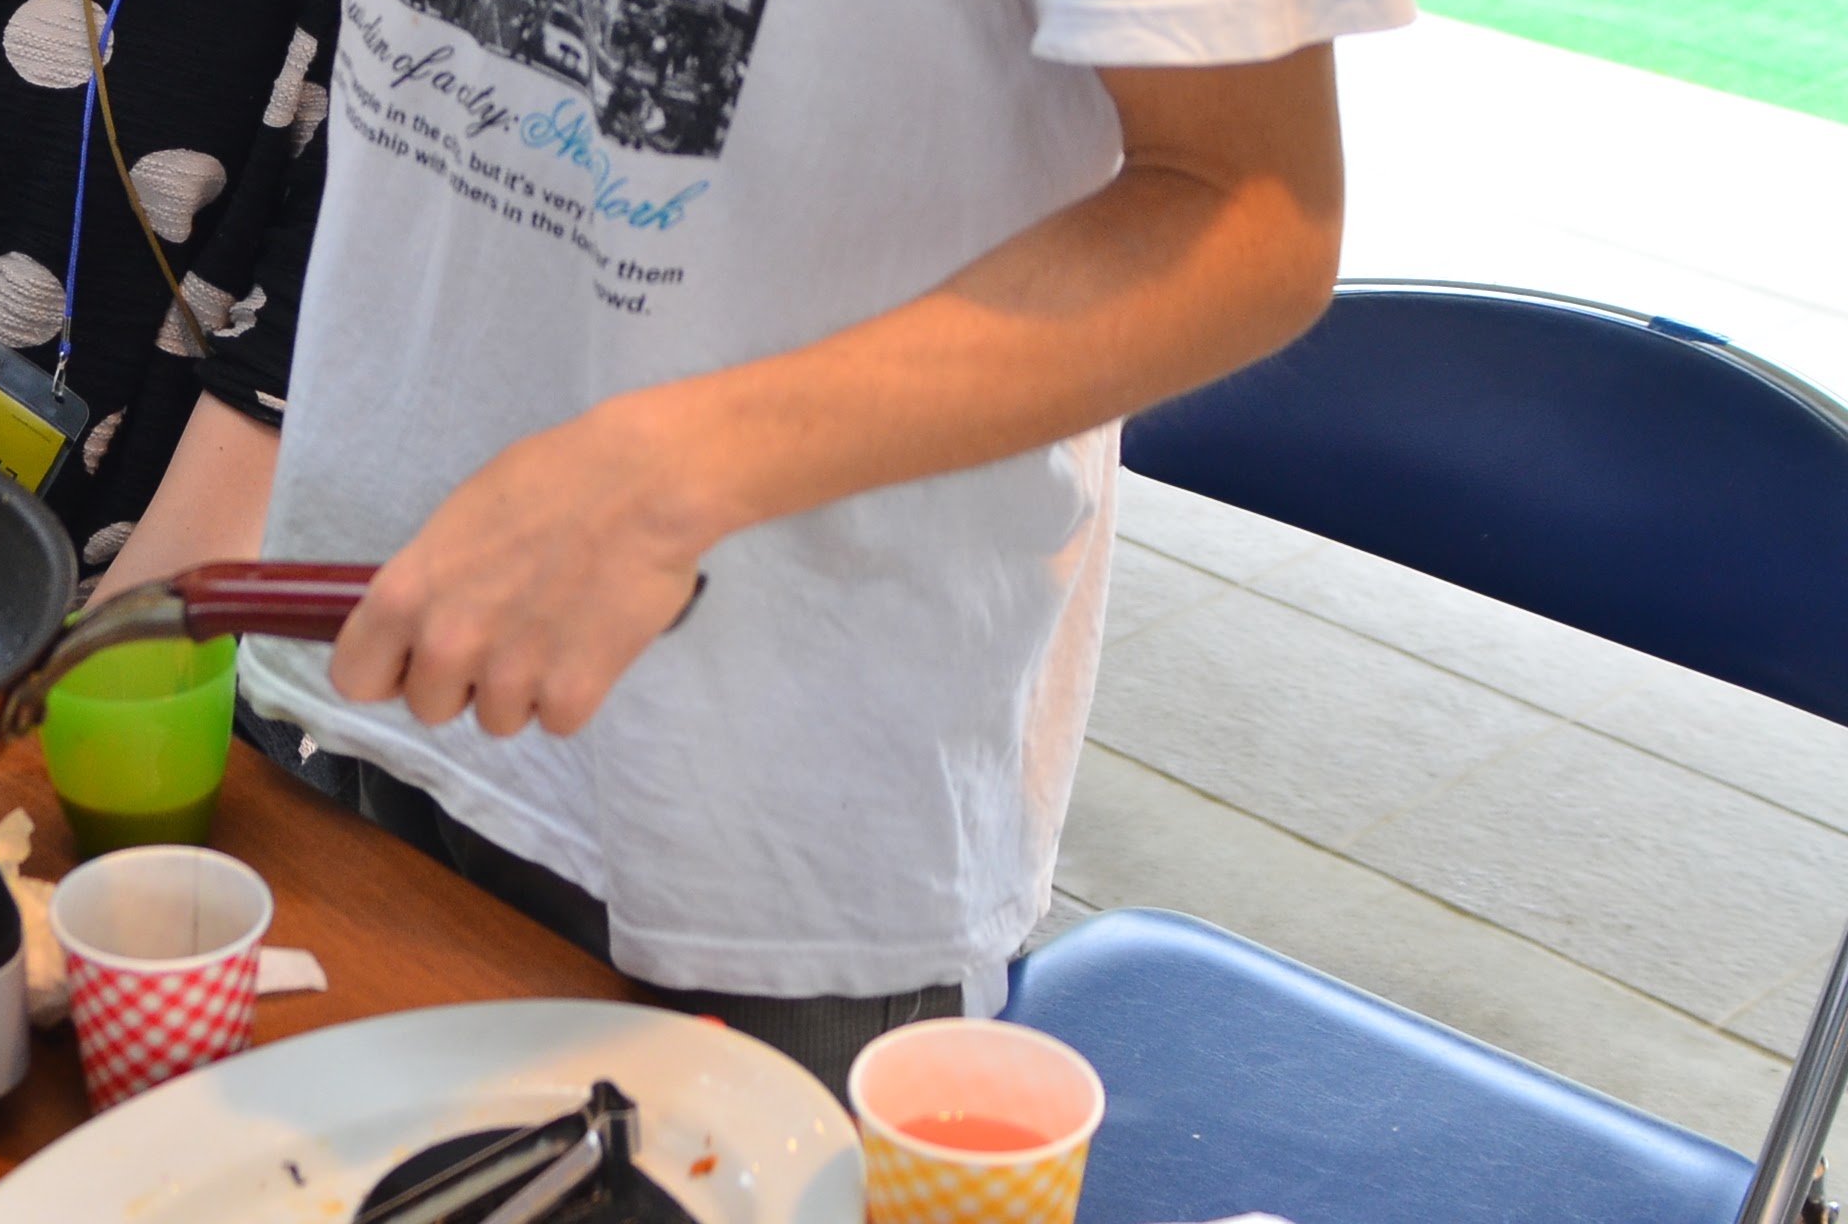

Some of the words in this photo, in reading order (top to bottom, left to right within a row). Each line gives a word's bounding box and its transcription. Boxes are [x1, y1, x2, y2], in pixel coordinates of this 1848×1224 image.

[390, 44, 454, 89] of
[386, 103, 406, 124] in
[412, 114, 440, 140] the
[469, 152, 501, 182] but
[504, 168, 535, 197] it's
[543, 188, 585, 222] very
[617, 259, 684, 285] them
[504, 201, 523, 223] in
[532, 210, 564, 238] the
